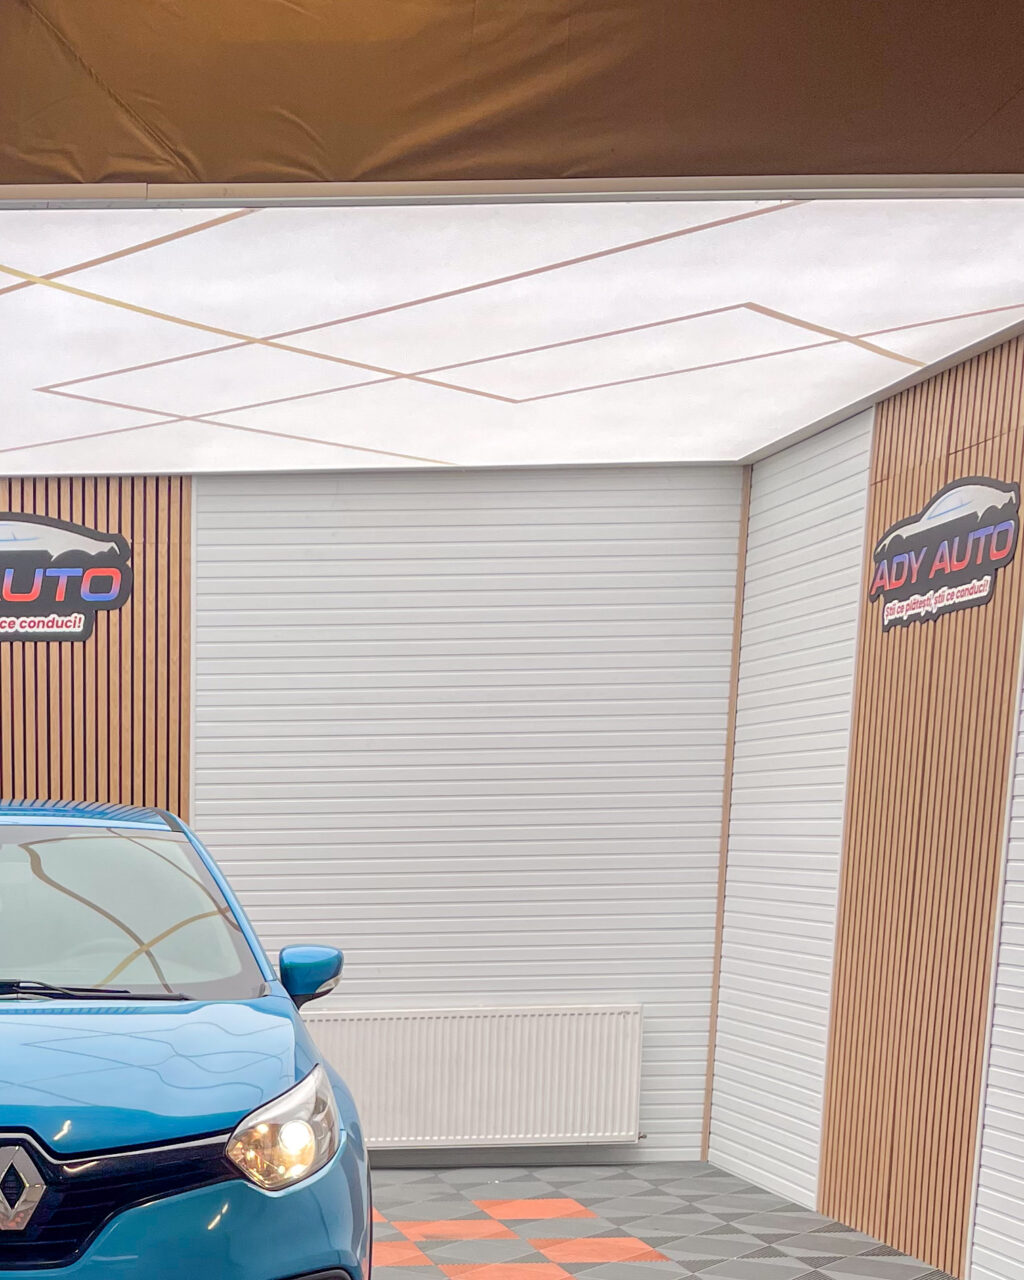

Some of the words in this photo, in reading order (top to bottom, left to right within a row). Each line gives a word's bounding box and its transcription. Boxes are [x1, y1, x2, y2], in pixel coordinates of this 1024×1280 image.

[870, 547, 928, 595] ADY
[929, 520, 1015, 578] AUTO
[0, 619, 16, 630] ce
[19, 616, 82, 630] conduci!
